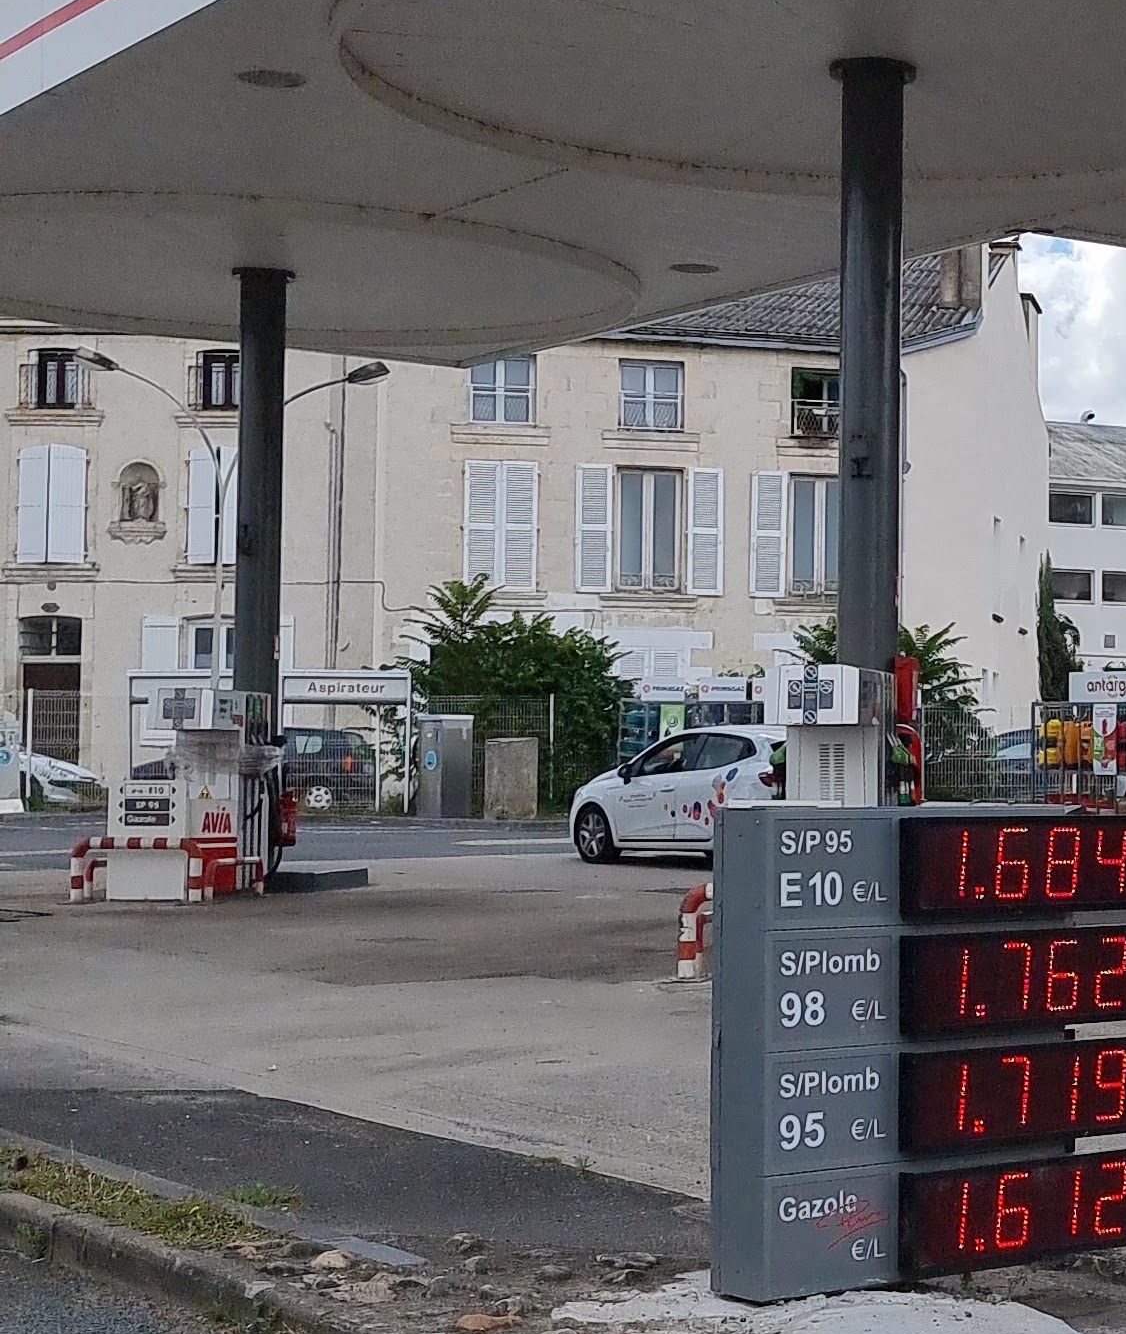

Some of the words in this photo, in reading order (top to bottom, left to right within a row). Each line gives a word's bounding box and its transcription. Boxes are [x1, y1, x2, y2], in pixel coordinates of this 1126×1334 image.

[307, 681, 386, 696] Aspirateur
[852, 880, 888, 902] €/L
[780, 948, 881, 976] S/Plomb
[780, 991, 826, 1028] 98
[851, 999, 887, 1021] €/L
[779, 1066, 880, 1099] S/Plomb
[780, 1112, 826, 1151] 95
[851, 1118, 887, 1141] €/L
[779, 1189, 858, 1222] Gazole
[851, 1237, 887, 1261] €/L
